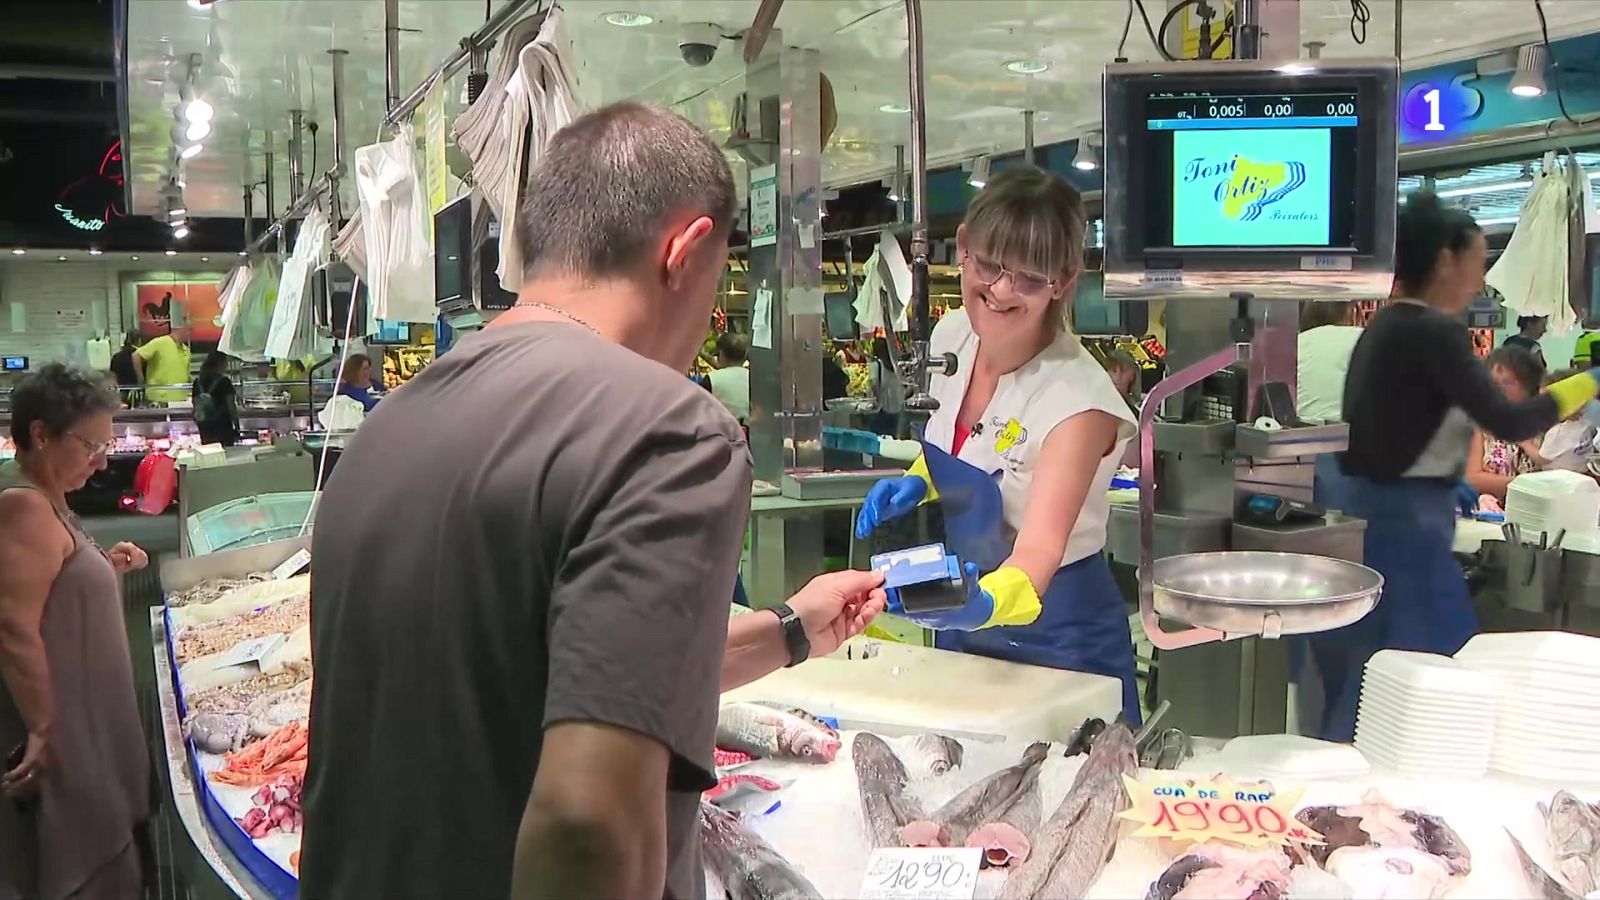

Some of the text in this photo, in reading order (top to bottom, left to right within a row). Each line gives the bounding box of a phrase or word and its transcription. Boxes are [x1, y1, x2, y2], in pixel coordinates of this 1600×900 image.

[1209, 104, 1244, 119] 0,005
[1264, 103, 1292, 119] 0,00
[1326, 103, 1355, 118] 0,00
[1184, 154, 1239, 183] Toni
[1214, 175, 1270, 203] Ortiz
[1153, 786, 1187, 798] CUA
[1199, 789, 1220, 800] DE
